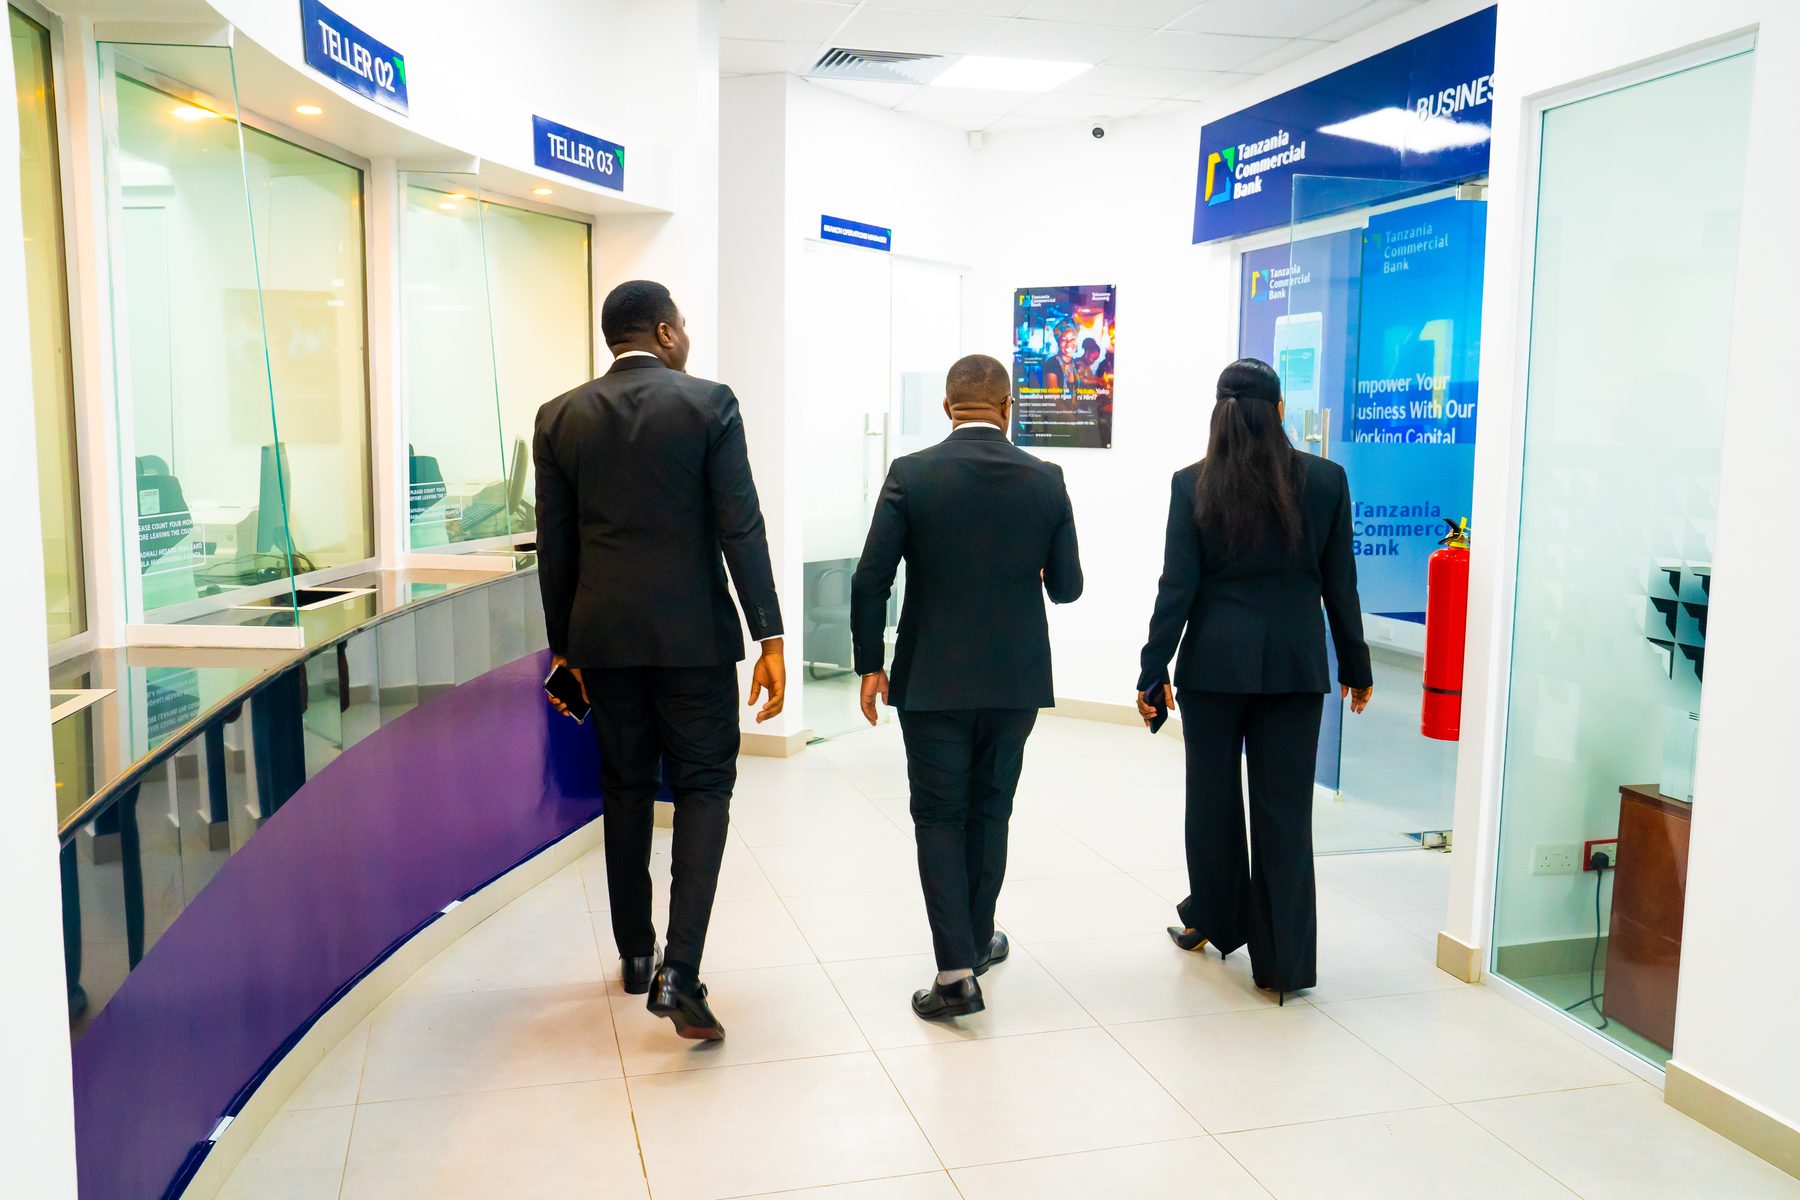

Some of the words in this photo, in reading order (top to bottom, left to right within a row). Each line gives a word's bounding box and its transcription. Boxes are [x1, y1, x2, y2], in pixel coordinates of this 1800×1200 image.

[319, 20, 373, 83] TELLER
[374, 57, 396, 92] 02
[547, 132, 595, 171] TELLER
[596, 149, 614, 175] 03
[1237, 129, 1290, 161] Tanzania
[1234, 140, 1306, 180] Commercial
[1233, 176, 1263, 200] Bank
[1384, 222, 1433, 244] Tanzania
[1383, 233, 1449, 259] Commercial
[1270, 264, 1301, 279] Tanzania
[1382, 260, 1410, 275] Bank
[1269, 272, 1311, 290] Commercial
[1268, 289, 1287, 301] Bank
[1416, 373, 1449, 391] Your
[1410, 402, 1443, 419] With
[1445, 399, 1476, 418] Our
[1405, 428, 1456, 444] Capital
[1354, 501, 1440, 517] Tanzania
[1352, 539, 1399, 555] Bank
